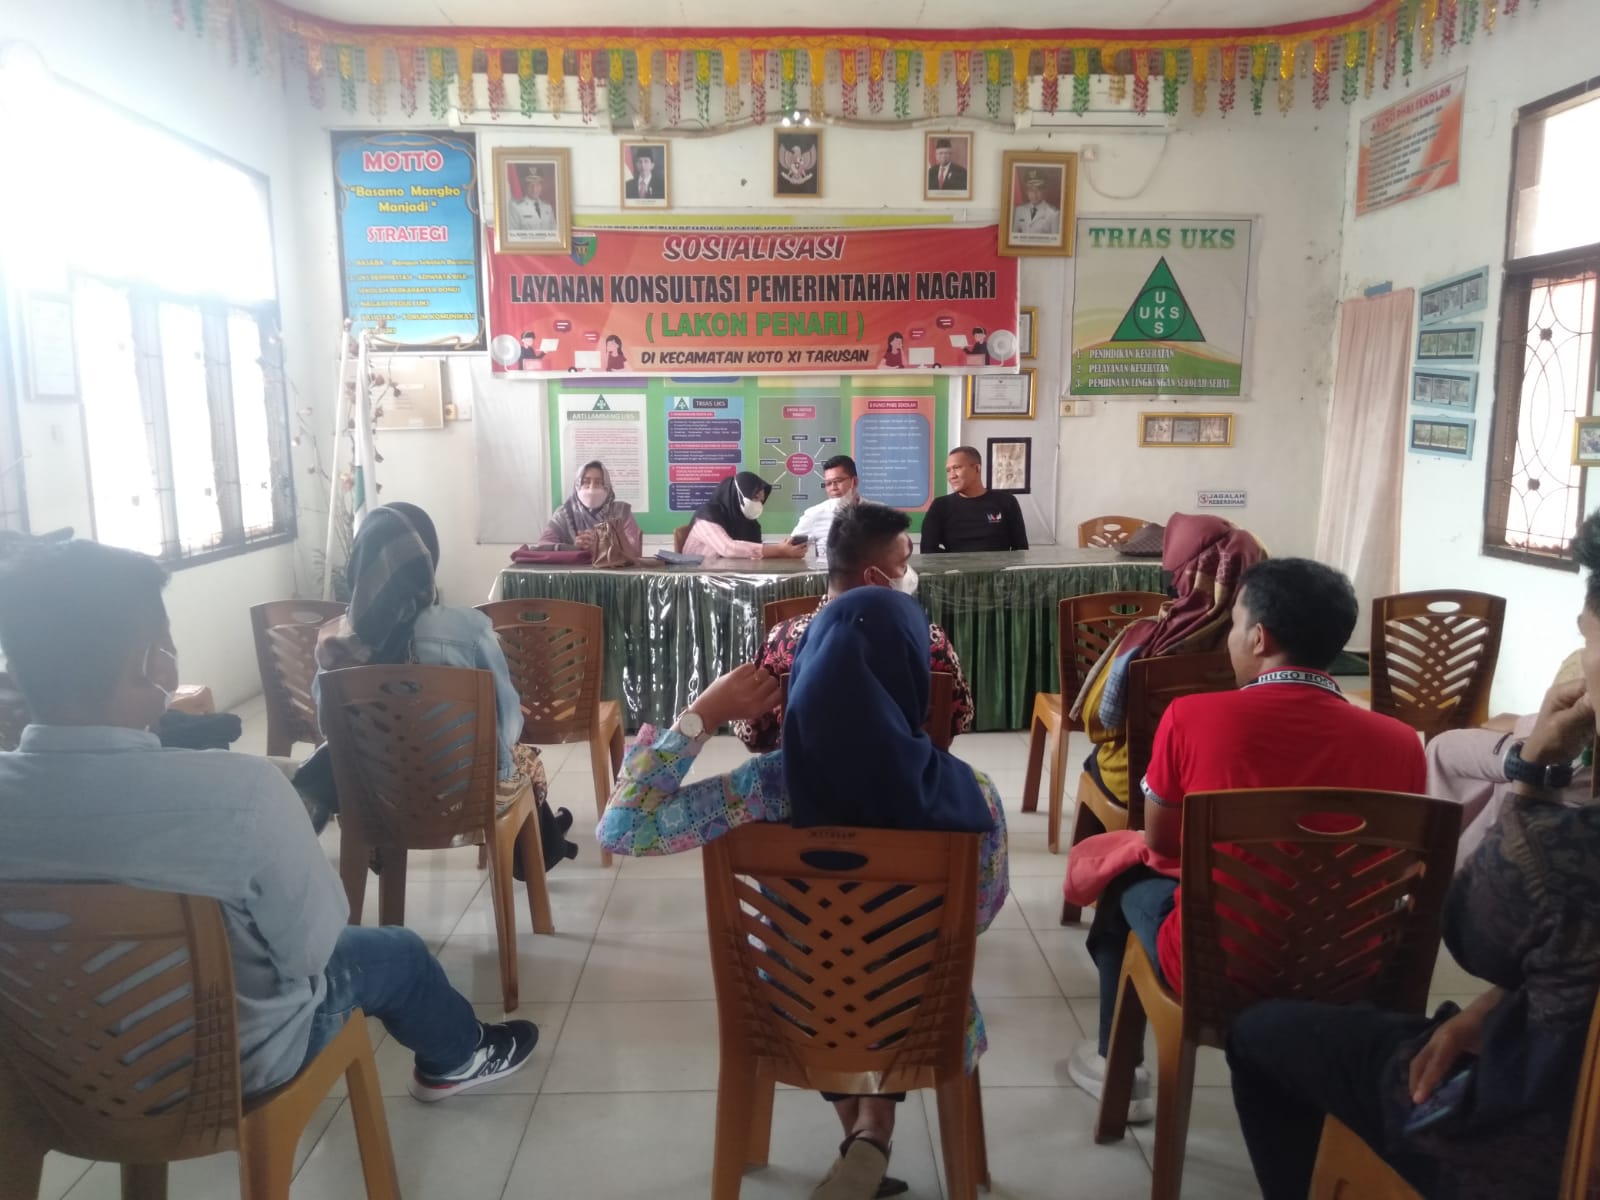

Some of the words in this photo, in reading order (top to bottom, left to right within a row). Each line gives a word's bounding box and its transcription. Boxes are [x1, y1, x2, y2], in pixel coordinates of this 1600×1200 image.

[362, 149, 444, 172] MOTTO
[410, 185, 460, 198] Mangko
[378, 201, 429, 213] Manjadi
[367, 225, 449, 243] STRATEGI
[1089, 228, 1171, 249] TRIAS
[1180, 228, 1236, 249] UKS
[663, 233, 847, 261] SOSIALISASI
[510, 273, 604, 304] LAYANAN
[610, 273, 741, 304] KONSULTASI
[747, 272, 910, 303] PEMERINTAHAN
[916, 271, 997, 300] NAGARI
[1155, 291, 1166, 304] U
[661, 312, 748, 337] LAKON
[755, 311, 849, 337] PENARI
[1154, 322, 1164, 334] S
[641, 351, 655, 365] DI
[659, 351, 744, 365] KECAMATAN
[747, 350, 783, 364] KOTO
[787, 350, 802, 363] XI
[806, 349, 869, 363] TARUSAN
[1089, 348, 1133, 359] PENDIDIKAN
[1135, 348, 1174, 359] KESEHATAN
[1089, 363, 1129, 373] PELAYANAN
[1130, 363, 1169, 373] KESEHATAN
[1088, 378, 1129, 388] PEMBINAAN
[1131, 378, 1175, 388] LINGKUNGAN
[1260, 671, 1300, 683] HUGO
